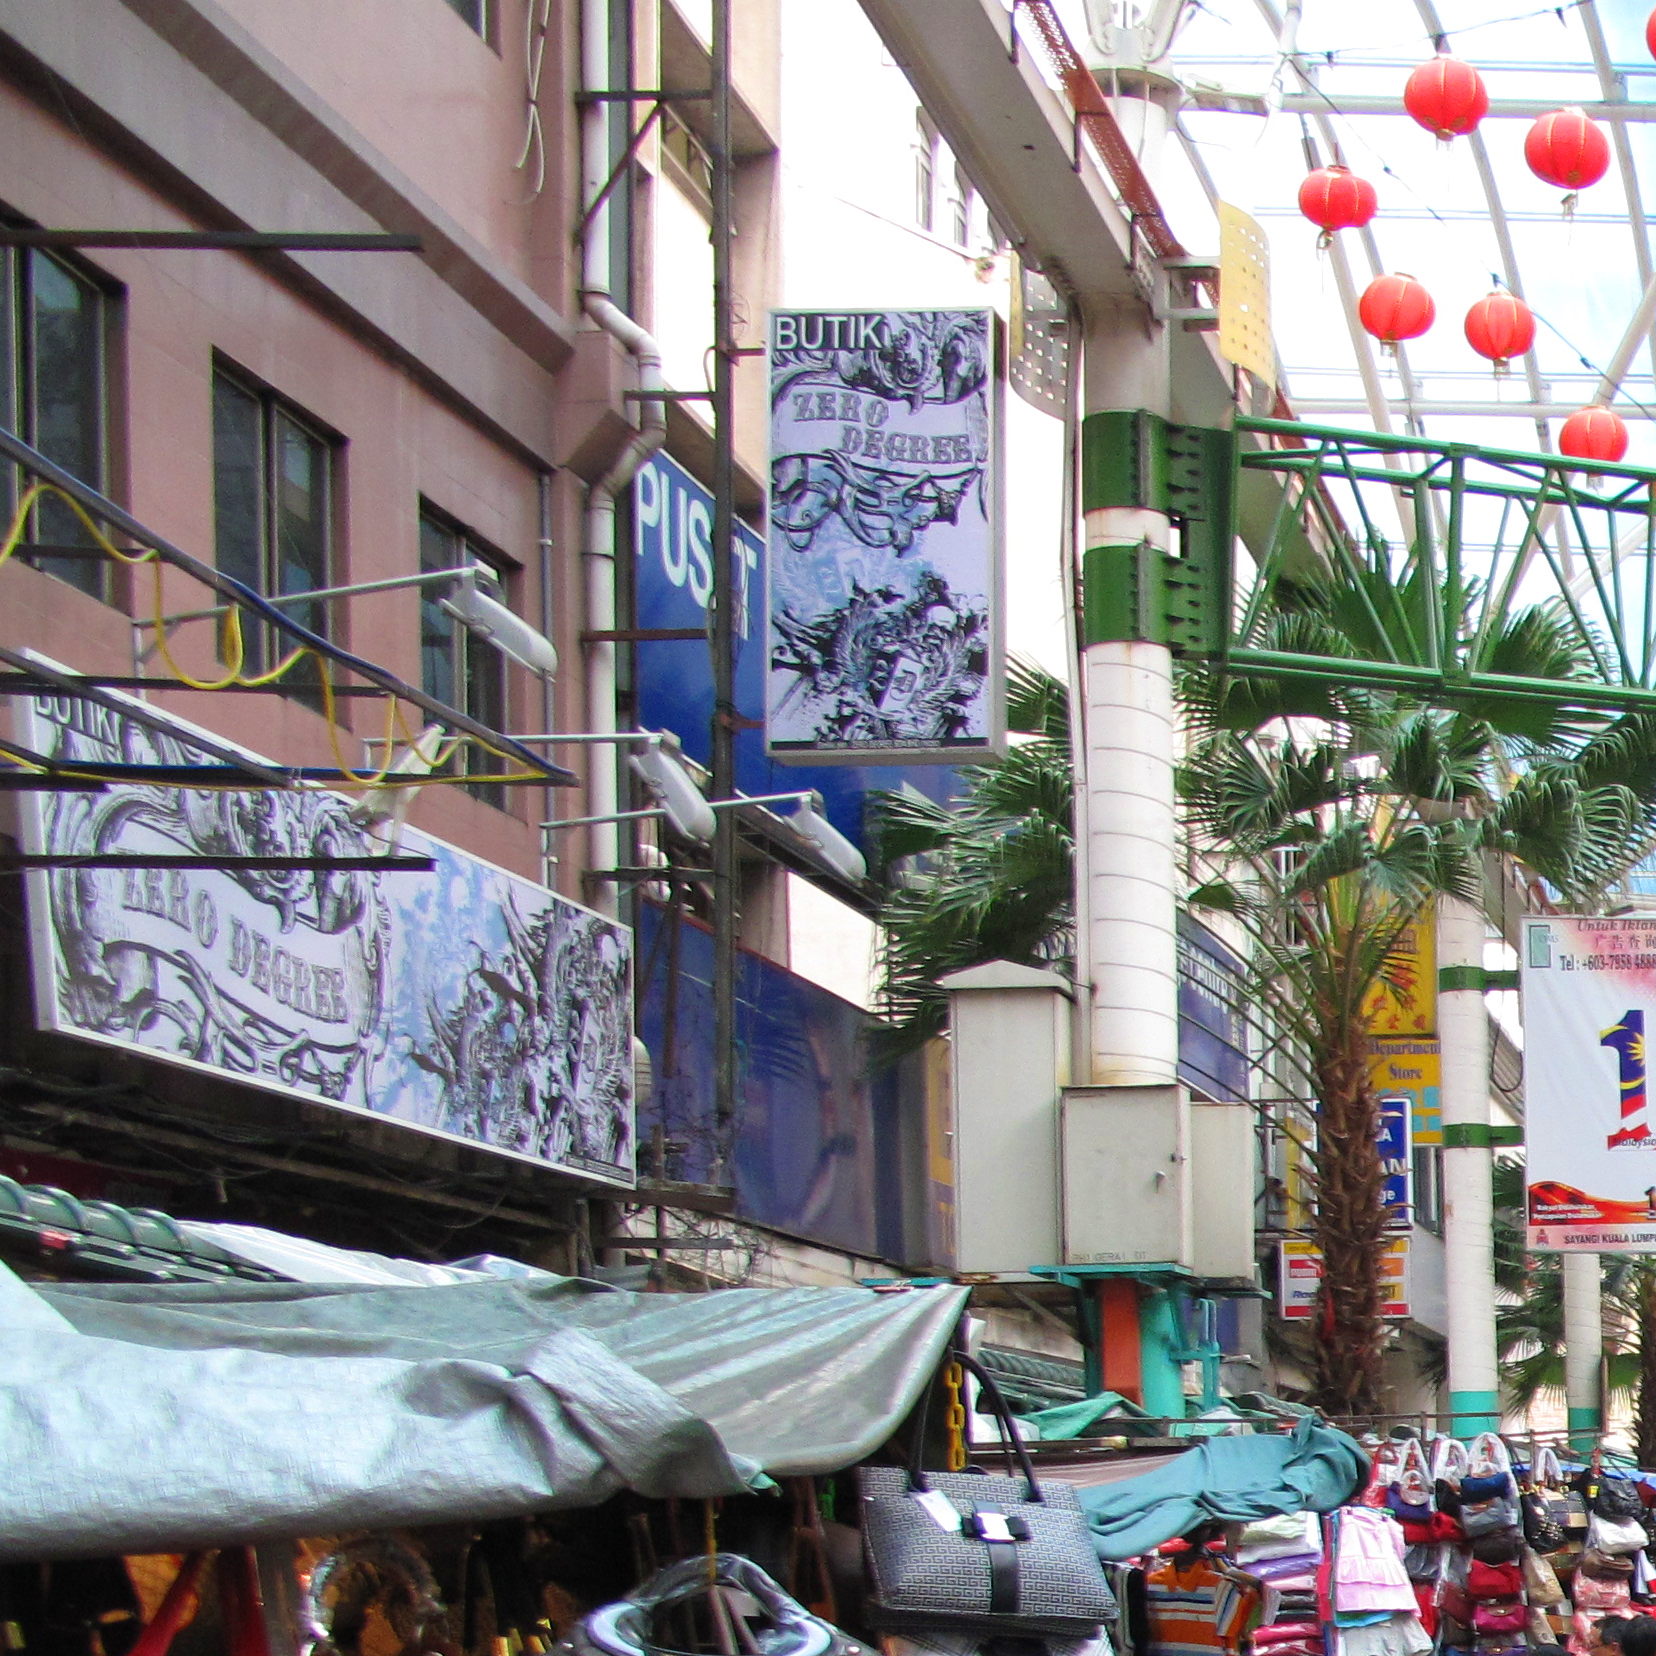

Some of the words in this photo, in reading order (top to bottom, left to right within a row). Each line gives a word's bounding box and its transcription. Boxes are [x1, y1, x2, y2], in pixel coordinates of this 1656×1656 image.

[775, 316, 883, 350] BUTIK
[792, 391, 889, 428] ZERO
[636, 460, 758, 641] PUST
[1621, 920, 1656, 931] Iklan
[1389, 1063, 1423, 1080] Store
[1564, 1235, 1601, 1244] SAYANGI
[1602, 1234, 1630, 1243] KUALA
